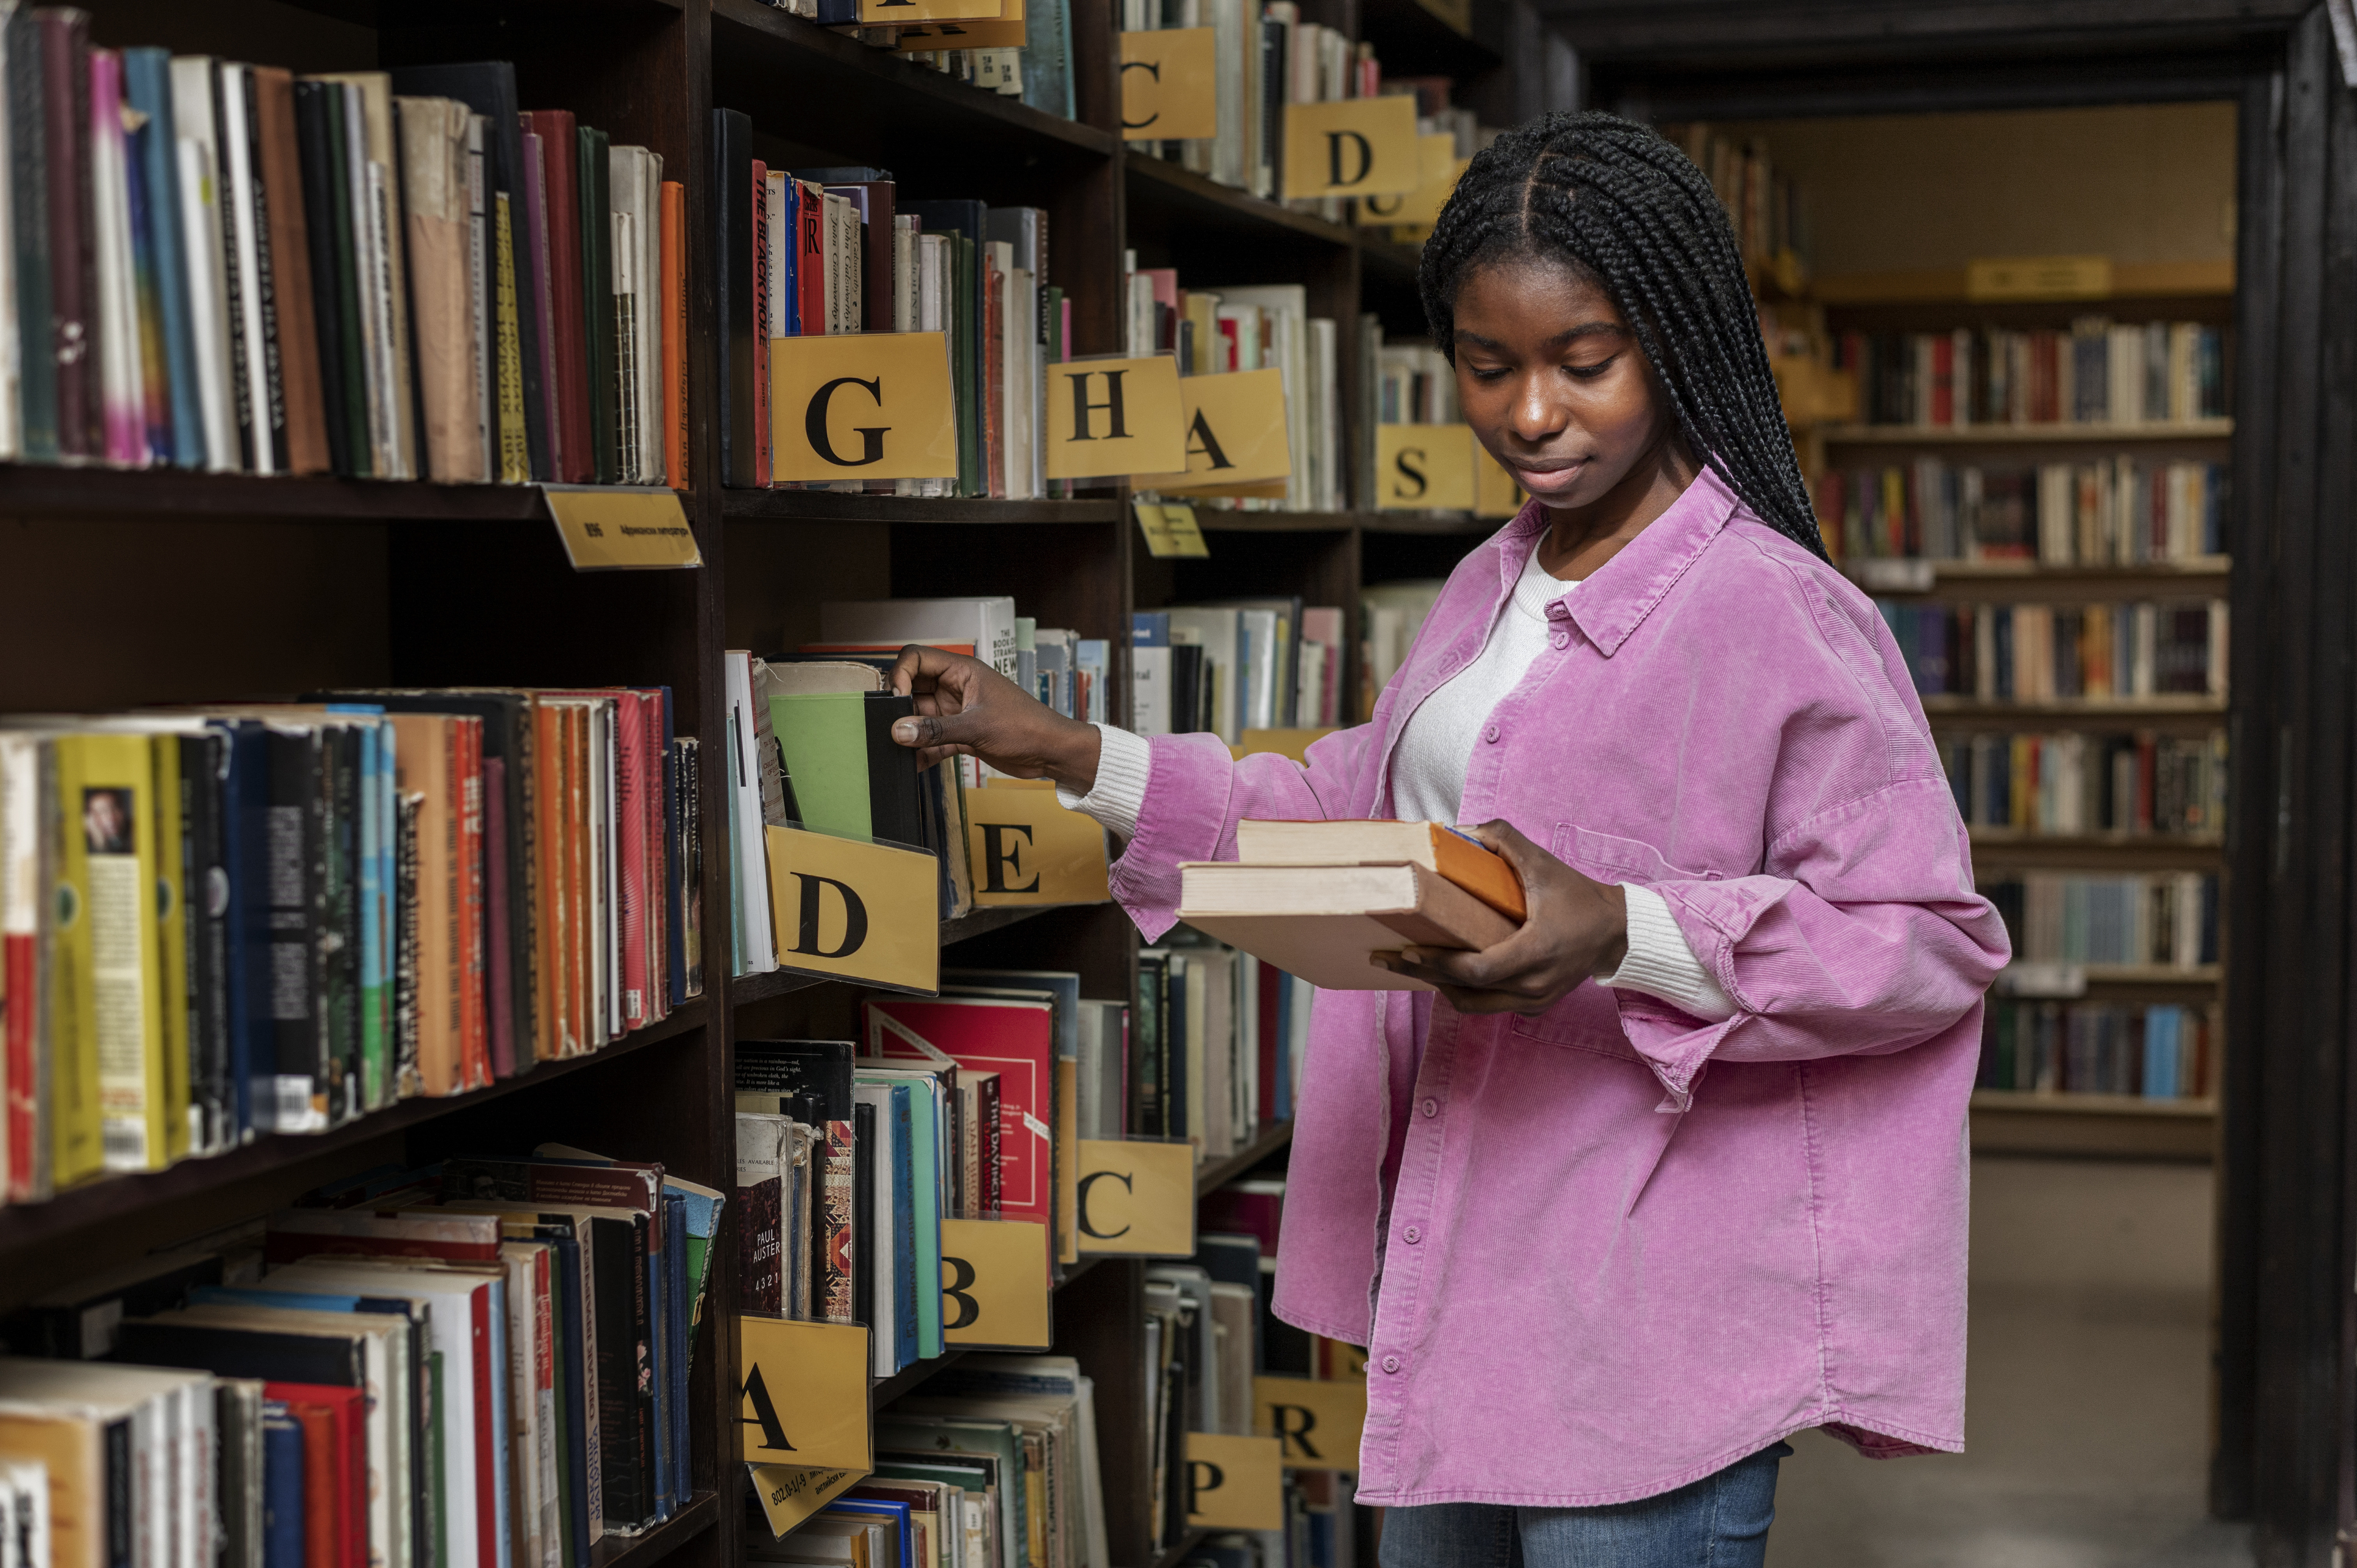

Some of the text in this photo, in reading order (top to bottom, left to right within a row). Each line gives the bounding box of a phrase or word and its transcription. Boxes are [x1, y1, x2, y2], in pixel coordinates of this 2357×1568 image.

[1322, 130, 1373, 187] D
[804, 198, 818, 212] Gaddis
[756, 178, 767, 350] THE BLACK HOLE
[804, 217, 820, 256] JR
[805, 376, 891, 466] G
[1065, 369, 1133, 441] H
[1186, 407, 1236, 473] A
[1394, 447, 1427, 500] S
[993, 639, 1009, 648] BOOK
[1001, 629, 1010, 637] THE
[994, 657, 1016, 673] NEW
[975, 823, 1039, 893] E
[787, 872, 868, 958] D
[990, 1096, 999, 1128] THE
[1078, 1171, 1133, 1239] C
[700, 1204, 721, 1288] Мураками
[753, 1241, 780, 1264] AUSTER
[758, 1229, 775, 1247] PAUL
[942, 1256, 979, 1329] B
[582, 1229, 598, 1421] ОБЛАК ВРАБЧЕТА
[742, 1362, 797, 1451] A
[1269, 1404, 1323, 1460] R
[593, 1424, 601, 1520] МАЦУОКА
[771, 1473, 806, 1506] 802.0-1/-9
[815, 1473, 839, 1495] английски
[1187, 1460, 1224, 1515] P
